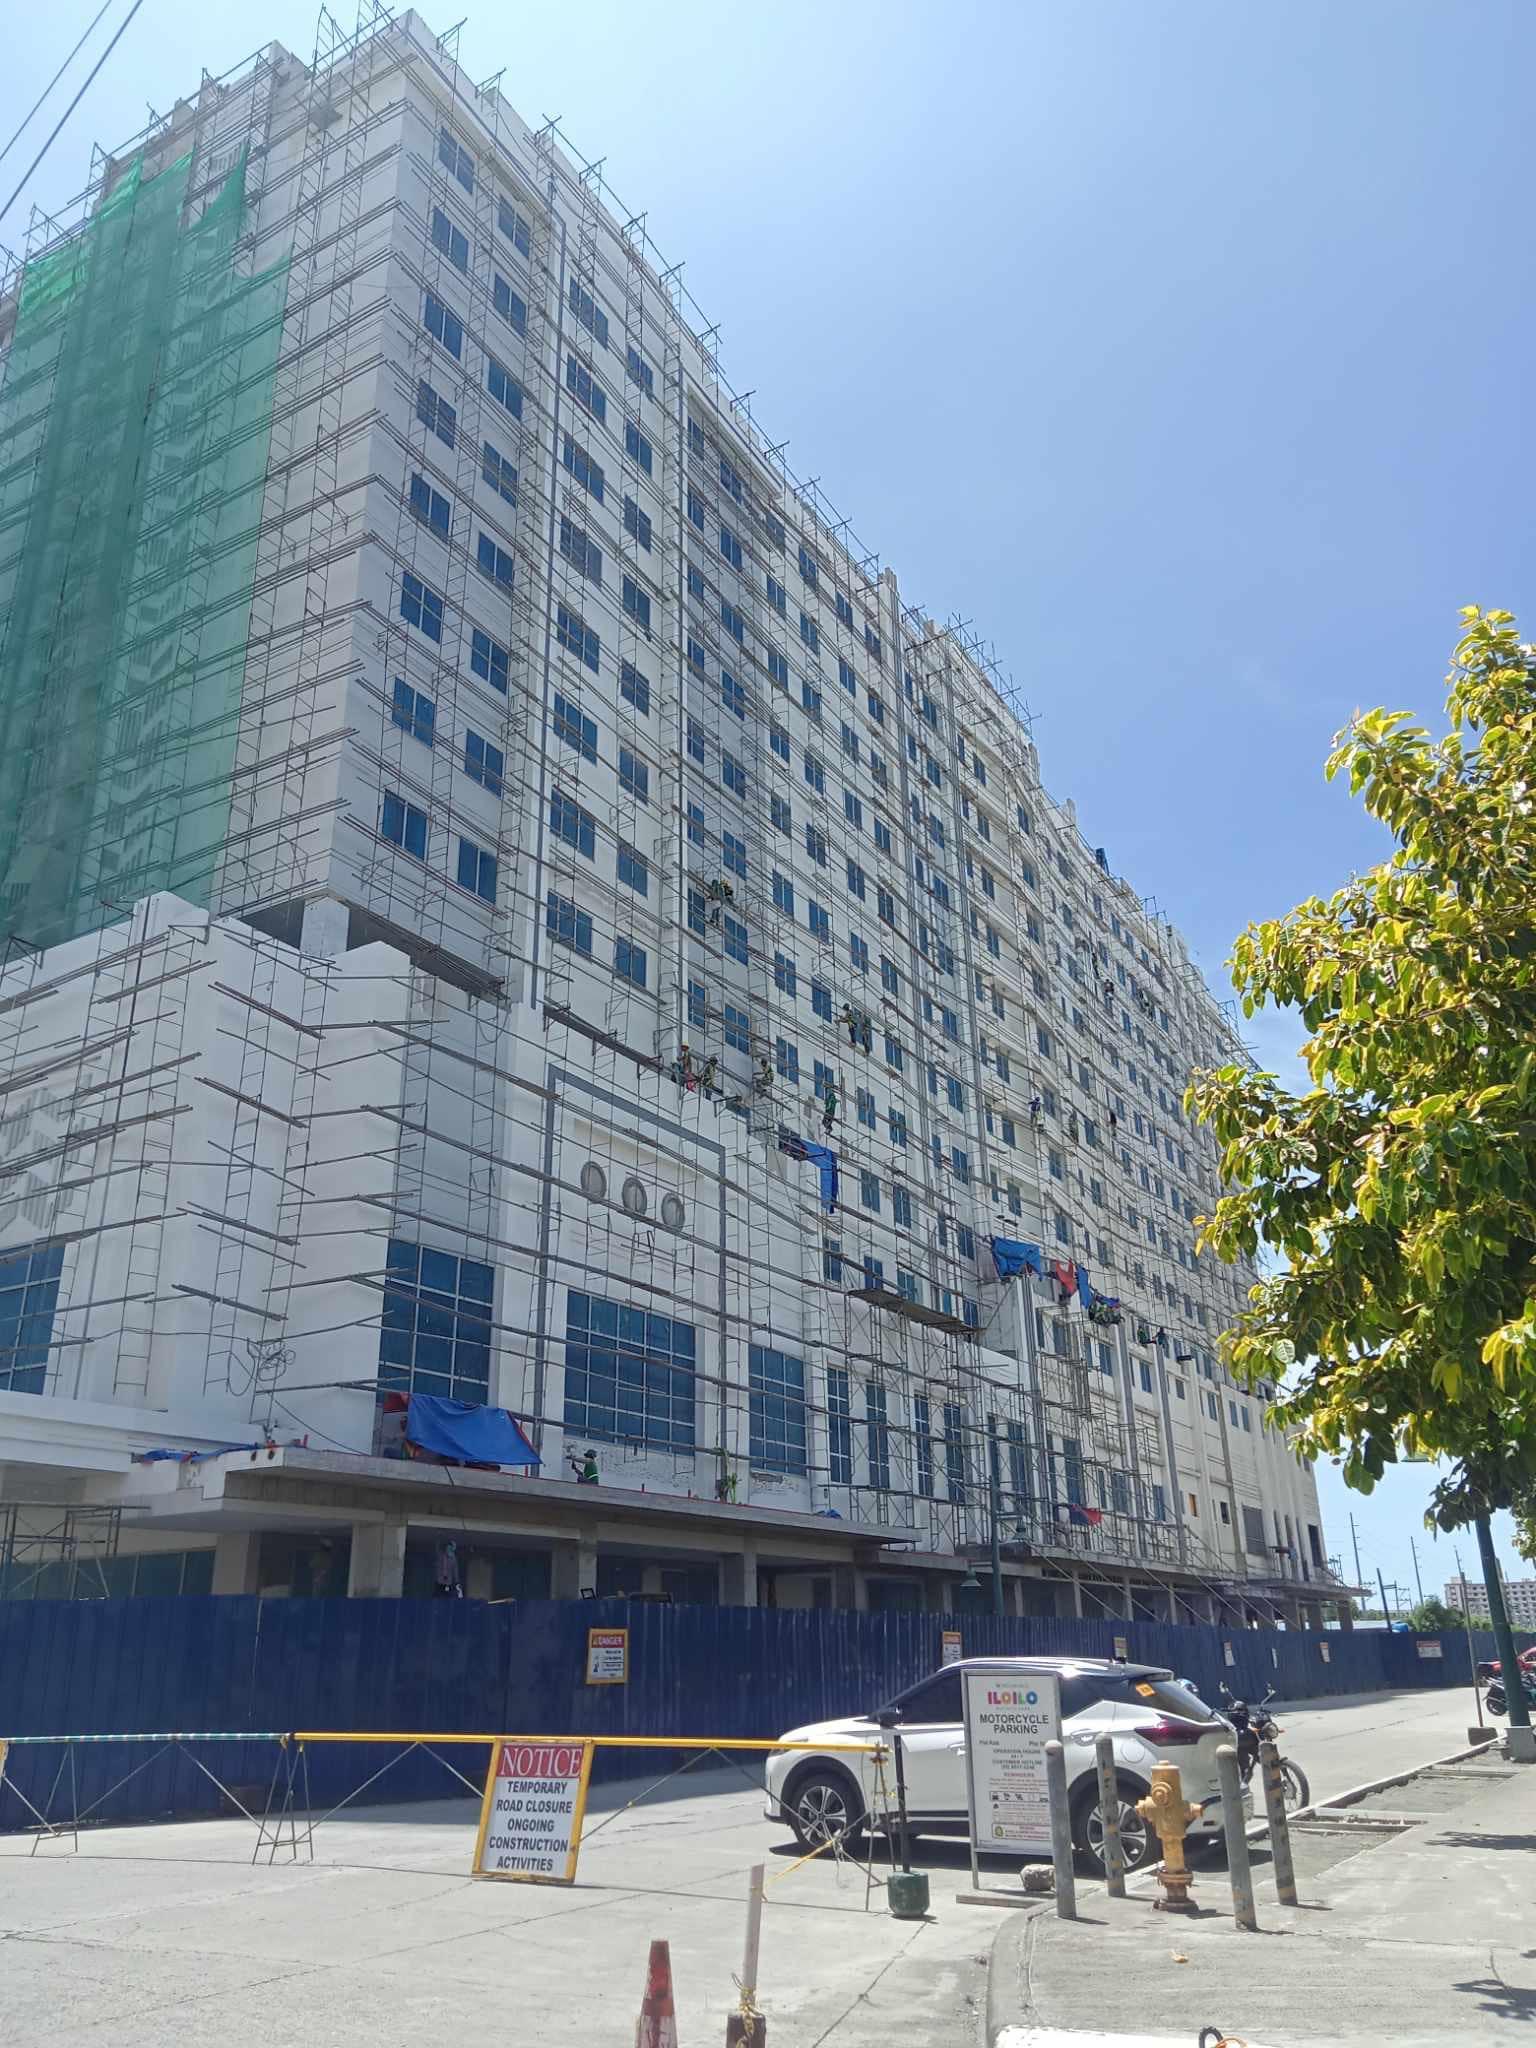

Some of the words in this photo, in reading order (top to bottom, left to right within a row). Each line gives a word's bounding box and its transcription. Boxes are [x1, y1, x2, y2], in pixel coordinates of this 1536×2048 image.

[987, 1691, 1038, 1705] ILOILO
[980, 1713, 1049, 1724] MOTORCYCLE
[993, 1724, 1038, 1734] PARKING
[500, 1747, 582, 1777] NOTICE
[507, 1781, 568, 1795] TEMPORARY
[496, 1799, 523, 1812] ROAD
[526, 1800, 573, 1814] CLOSURE
[507, 1818, 554, 1832] ONGOING
[489, 1836, 569, 1852] CONSTRUCTION
[496, 1856, 553, 1871] ACTIVITIES
